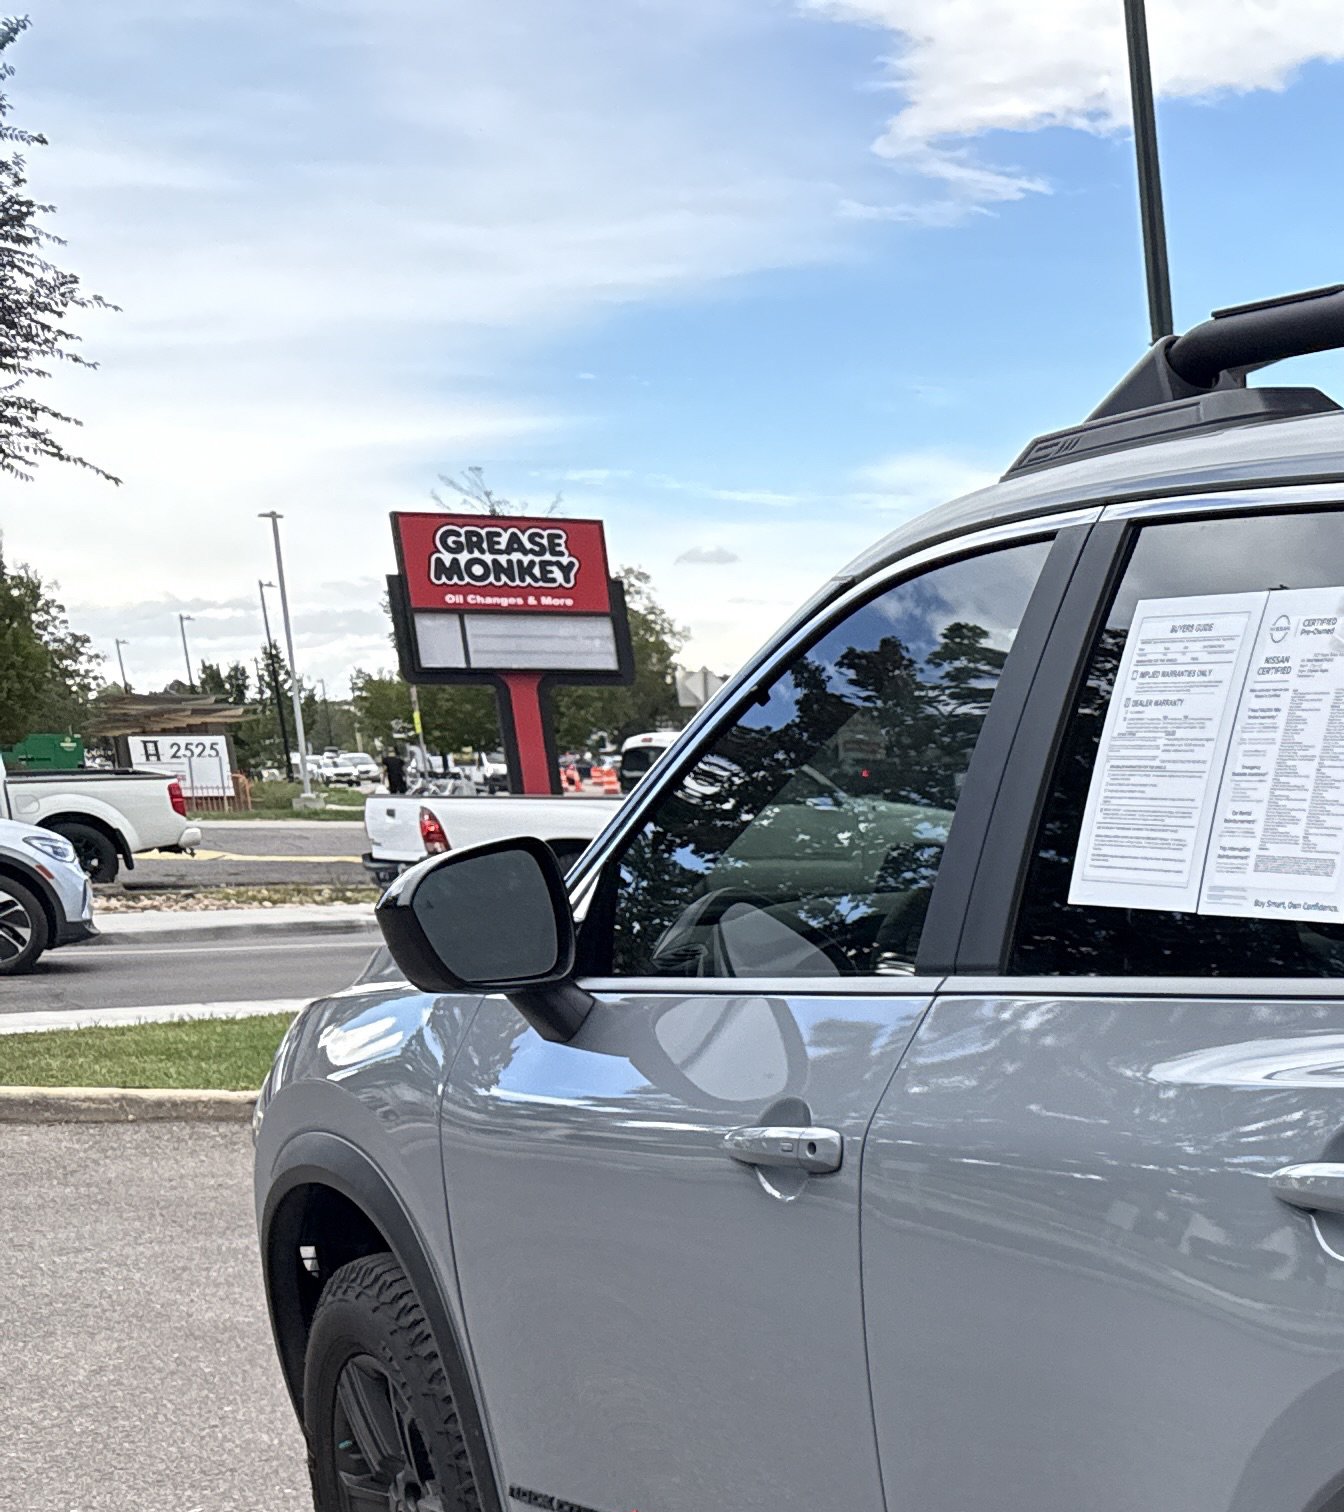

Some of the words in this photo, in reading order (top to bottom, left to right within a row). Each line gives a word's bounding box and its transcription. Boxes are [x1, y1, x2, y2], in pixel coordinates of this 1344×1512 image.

[438, 527, 566, 558] GREASE
[432, 556, 576, 586] MONKEY
[445, 594, 464, 604] Oil
[466, 594, 524, 607] Changes
[527, 596, 538, 606] &
[541, 596, 574, 607] More
[1264, 655, 1291, 665] NISSAN
[170, 742, 219, 759] 2525
